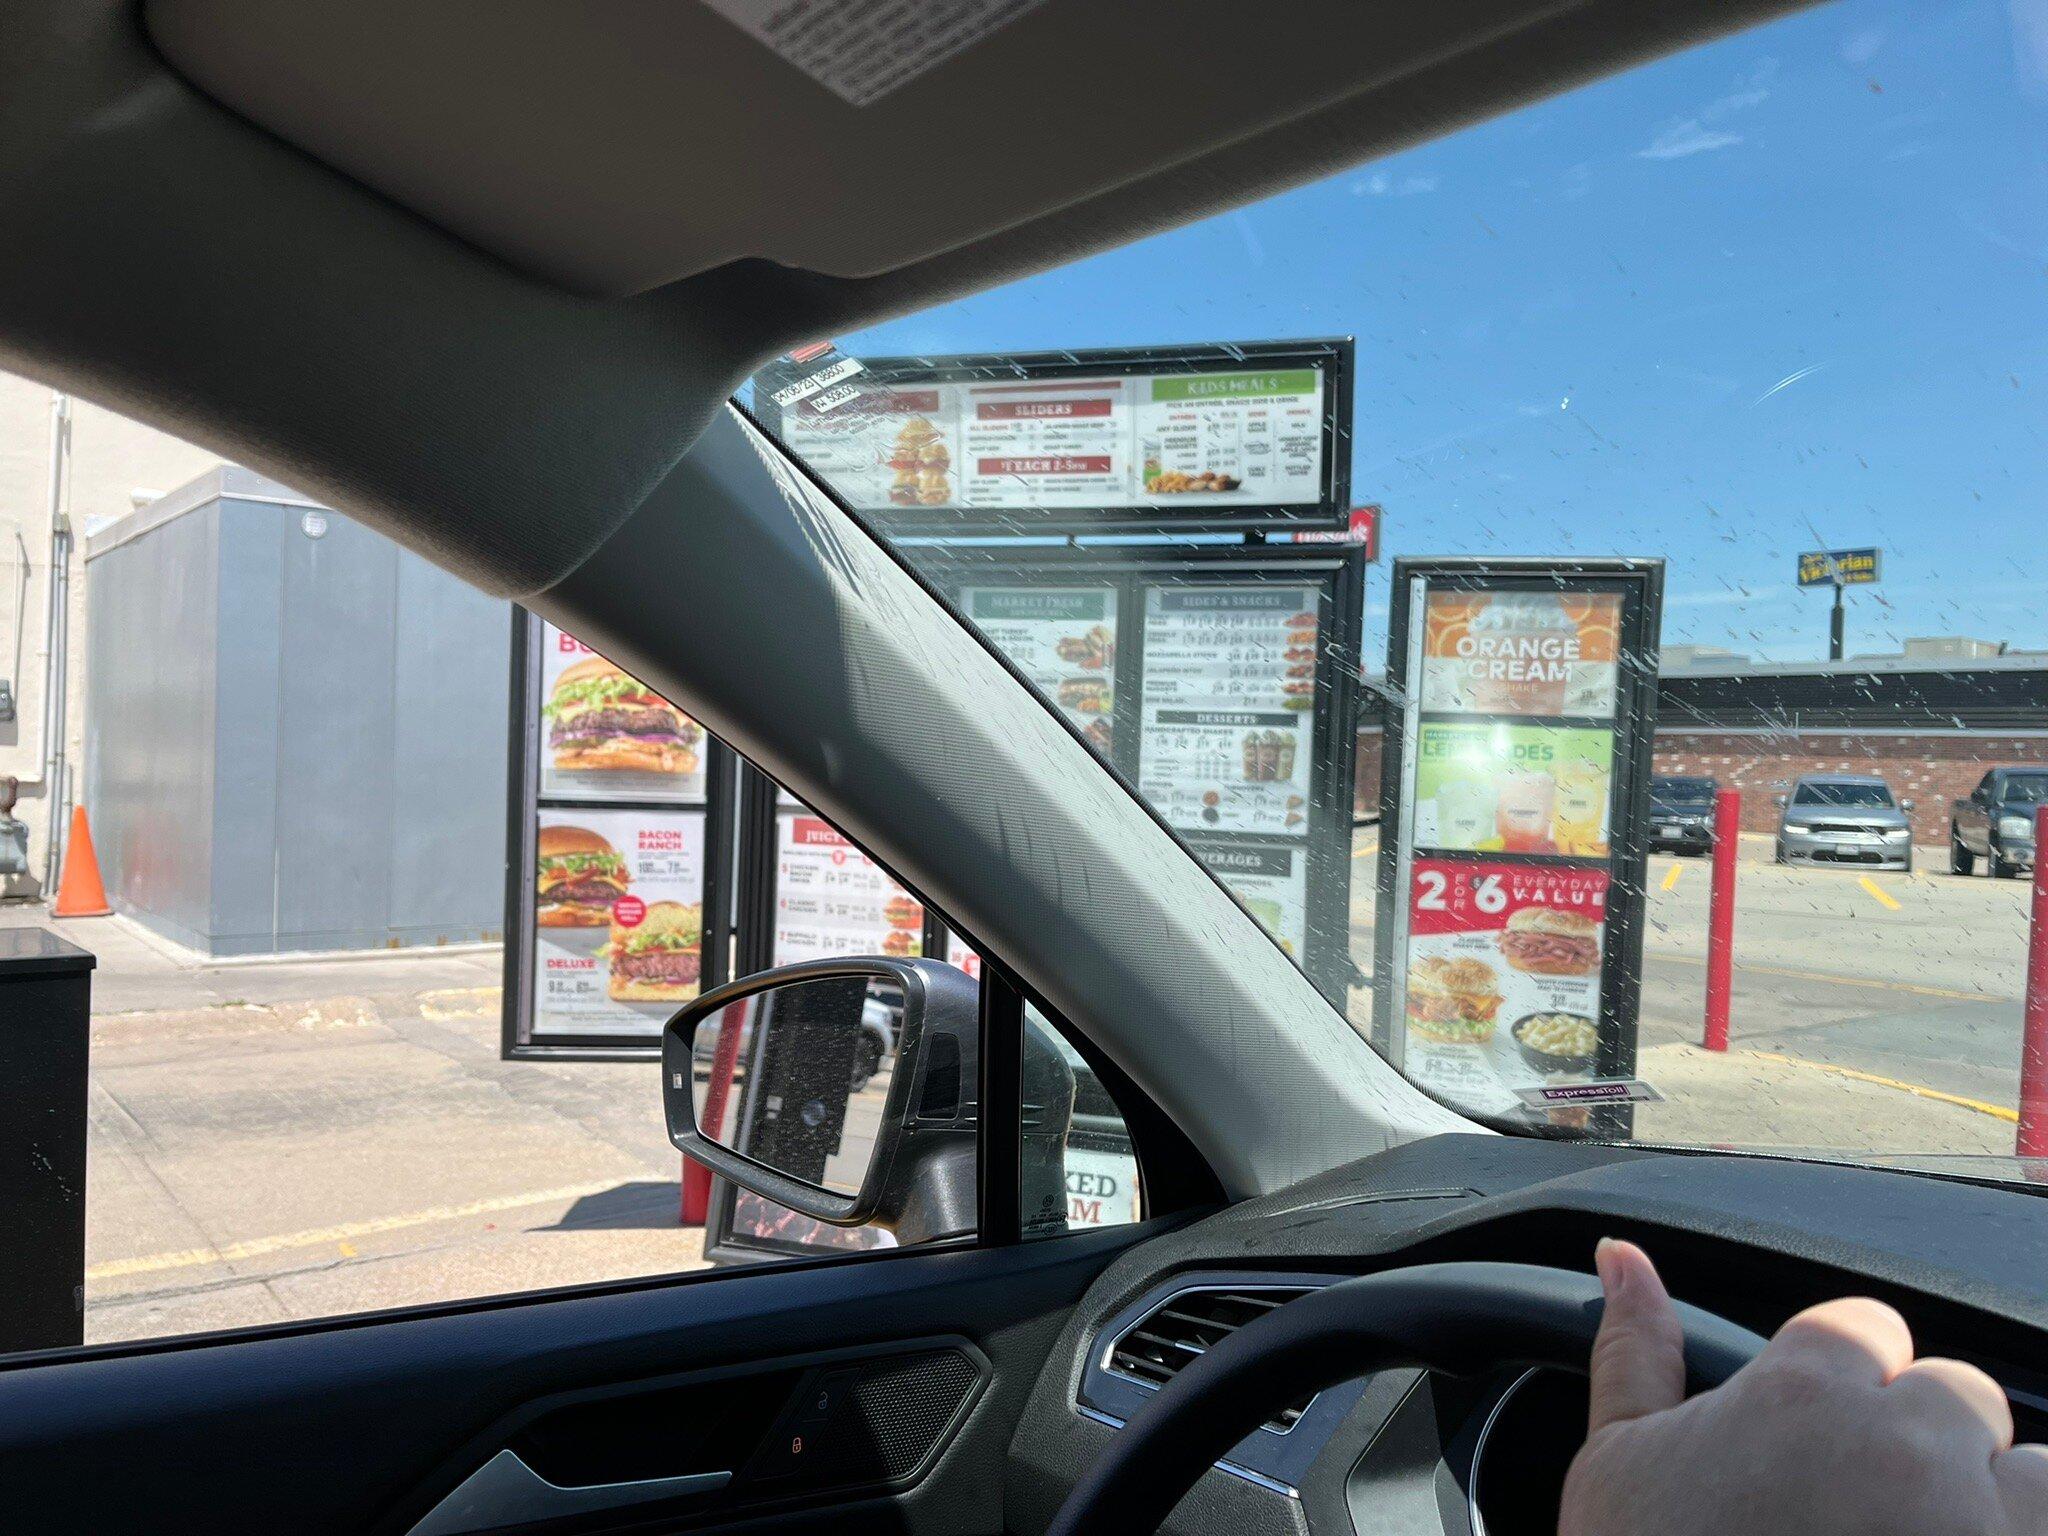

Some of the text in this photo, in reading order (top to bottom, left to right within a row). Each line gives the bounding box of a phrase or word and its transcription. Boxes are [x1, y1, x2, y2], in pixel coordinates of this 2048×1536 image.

[1187, 382, 1226, 395] KIDS
[1014, 404, 1073, 416] SLIDERS
[1456, 636, 1581, 660] ORANGE
[1466, 659, 1573, 682] CREAM
[1197, 713, 1258, 725] DESSERTS
[638, 830, 682, 839] BACON
[638, 841, 682, 850] RANCH
[1513, 874, 1605, 892] EVERYDAY
[1416, 870, 1447, 910] 2
[547, 958, 595, 969] DELUXE
[1545, 1085, 1624, 1098] ExpressToll
[1069, 1197, 1102, 1224] M
